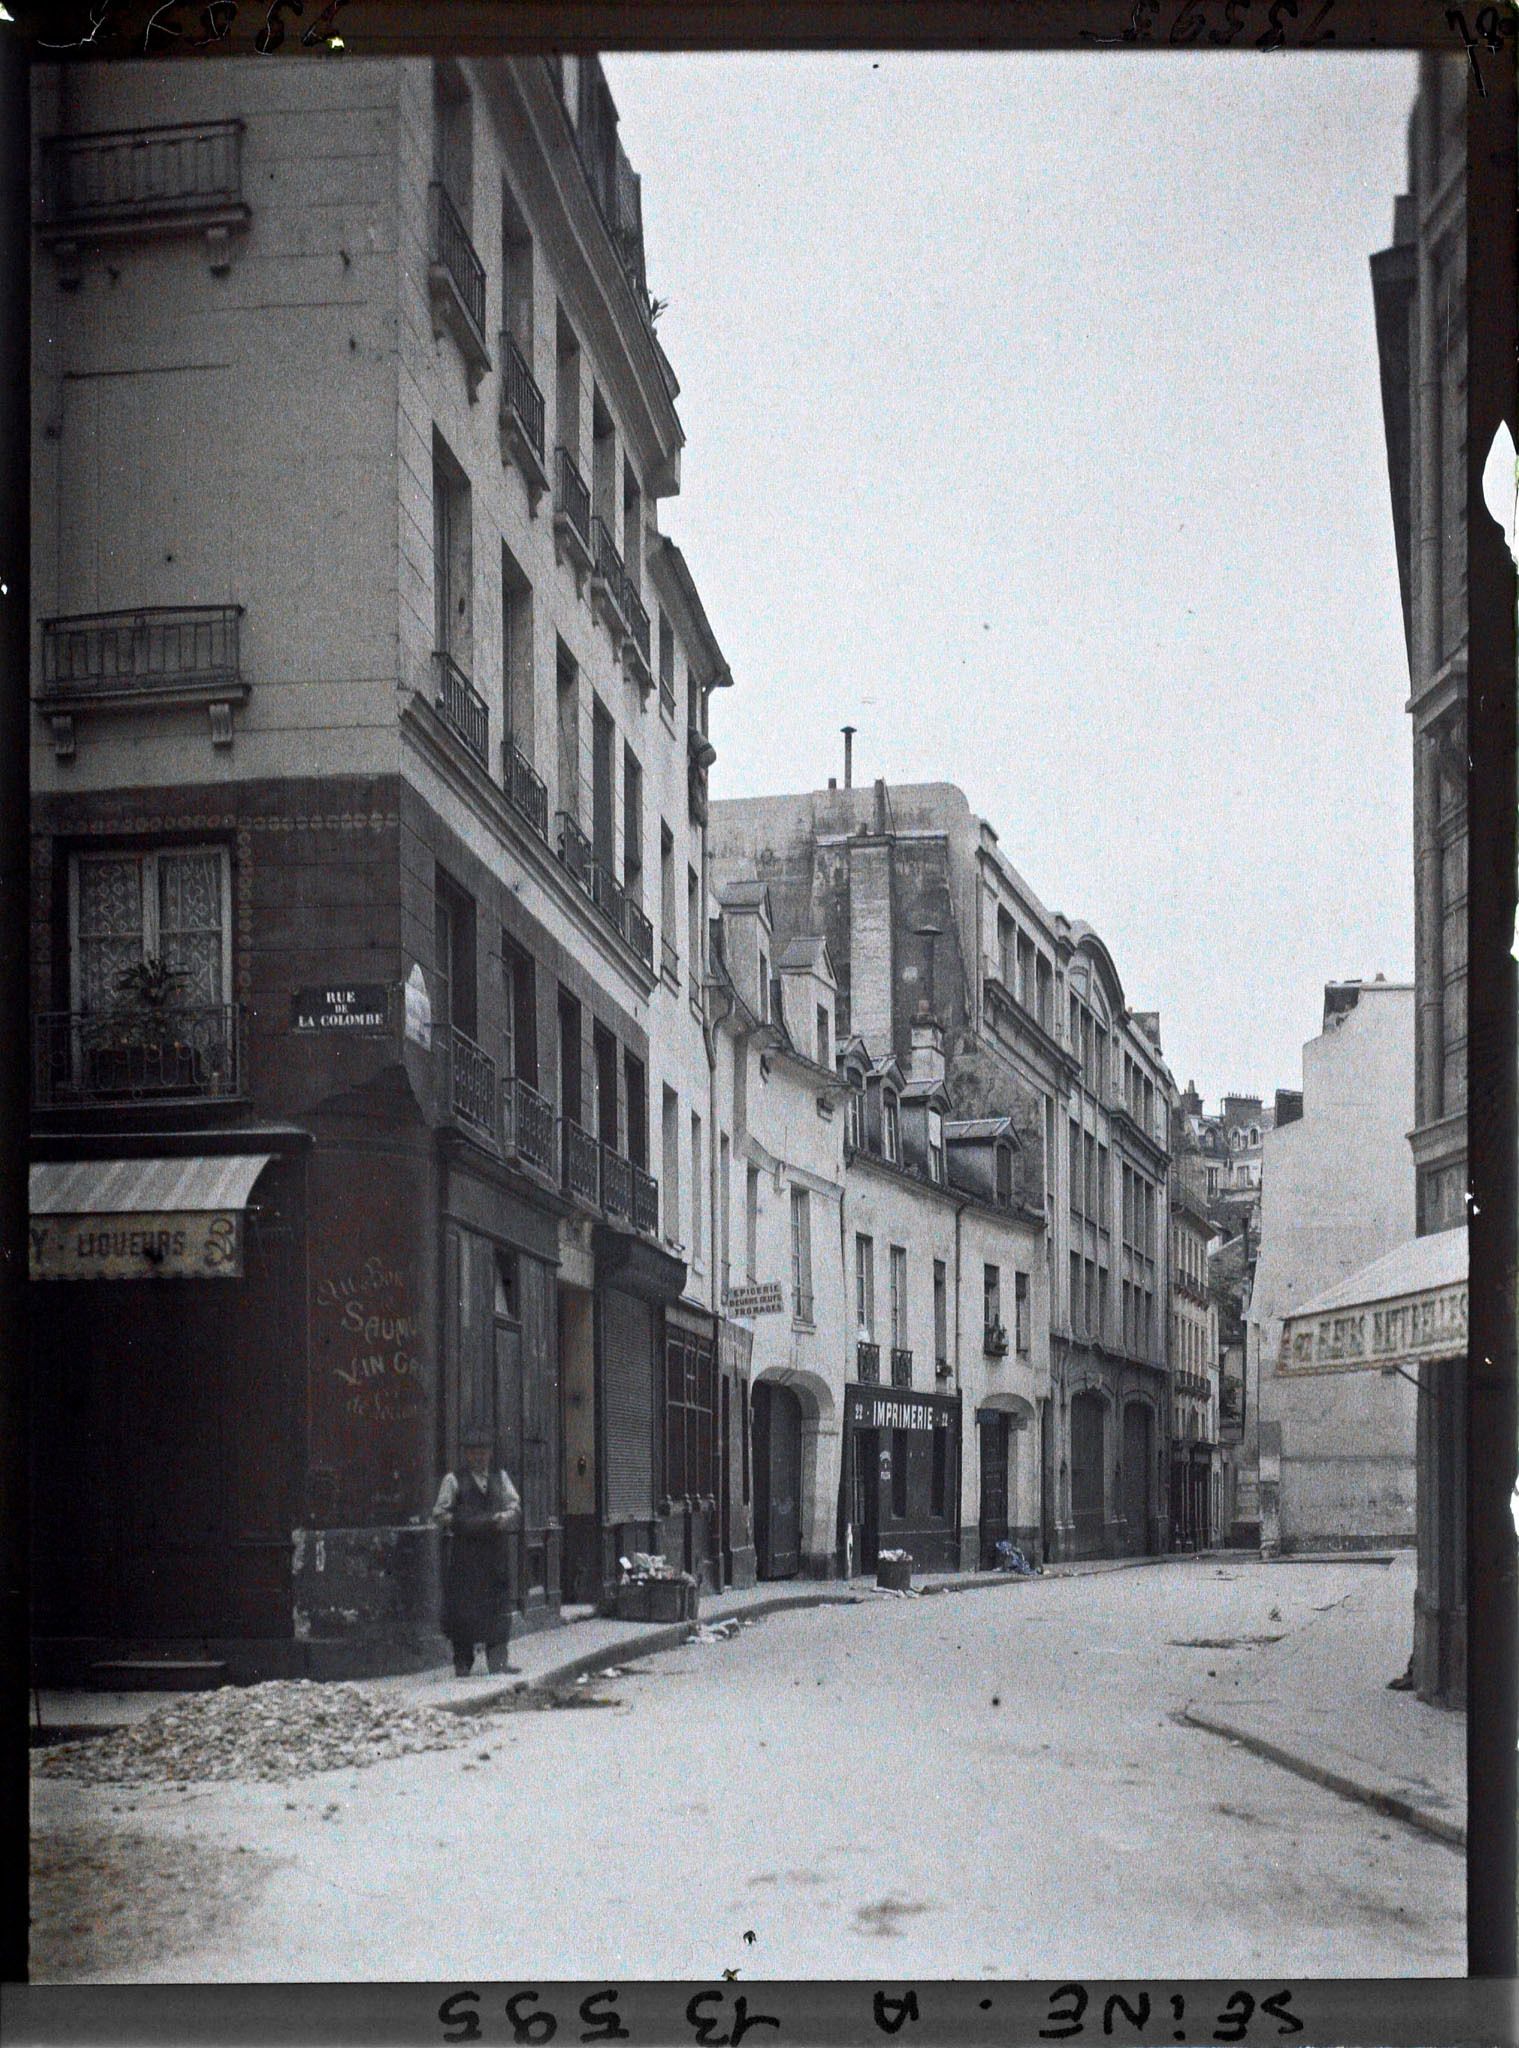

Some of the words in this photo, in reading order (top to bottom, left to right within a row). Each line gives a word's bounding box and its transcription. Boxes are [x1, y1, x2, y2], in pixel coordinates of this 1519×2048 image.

[326, 991, 356, 1003] RUE
[335, 1004, 348, 1013] DE
[298, 1015, 315, 1027] LA
[320, 1013, 384, 1027] COLOMBE
[76, 1231, 187, 1258] LIQUEURS
[733, 1284, 780, 1298] EPICERIE
[855, 1404, 863, 1420] 22
[873, 1400, 934, 1430] IMPRIMERIE
[438, 1989, 629, 2045] 595
